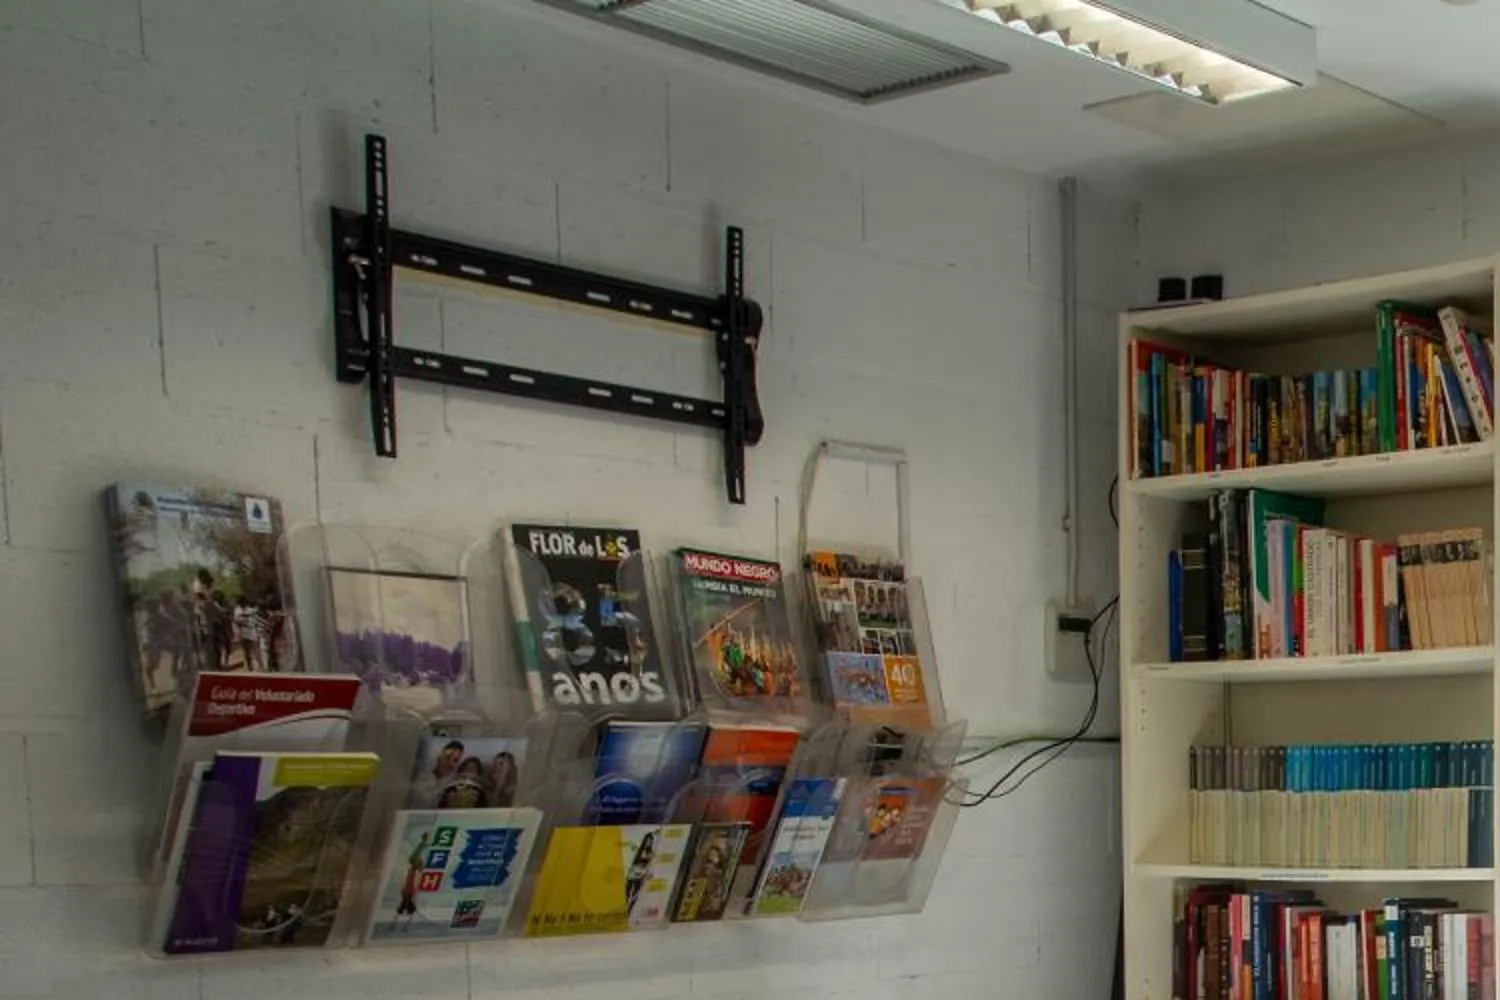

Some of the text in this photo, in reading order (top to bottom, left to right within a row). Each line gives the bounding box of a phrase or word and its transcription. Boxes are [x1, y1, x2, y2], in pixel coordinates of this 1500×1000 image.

[529, 531, 577, 556] FLOR
[578, 540, 594, 557] de
[686, 555, 731, 575] MUNDO
[552, 671, 666, 705] anos
[440, 830, 452, 844] S
[431, 853, 445, 867] F
[422, 875, 439, 889] H
